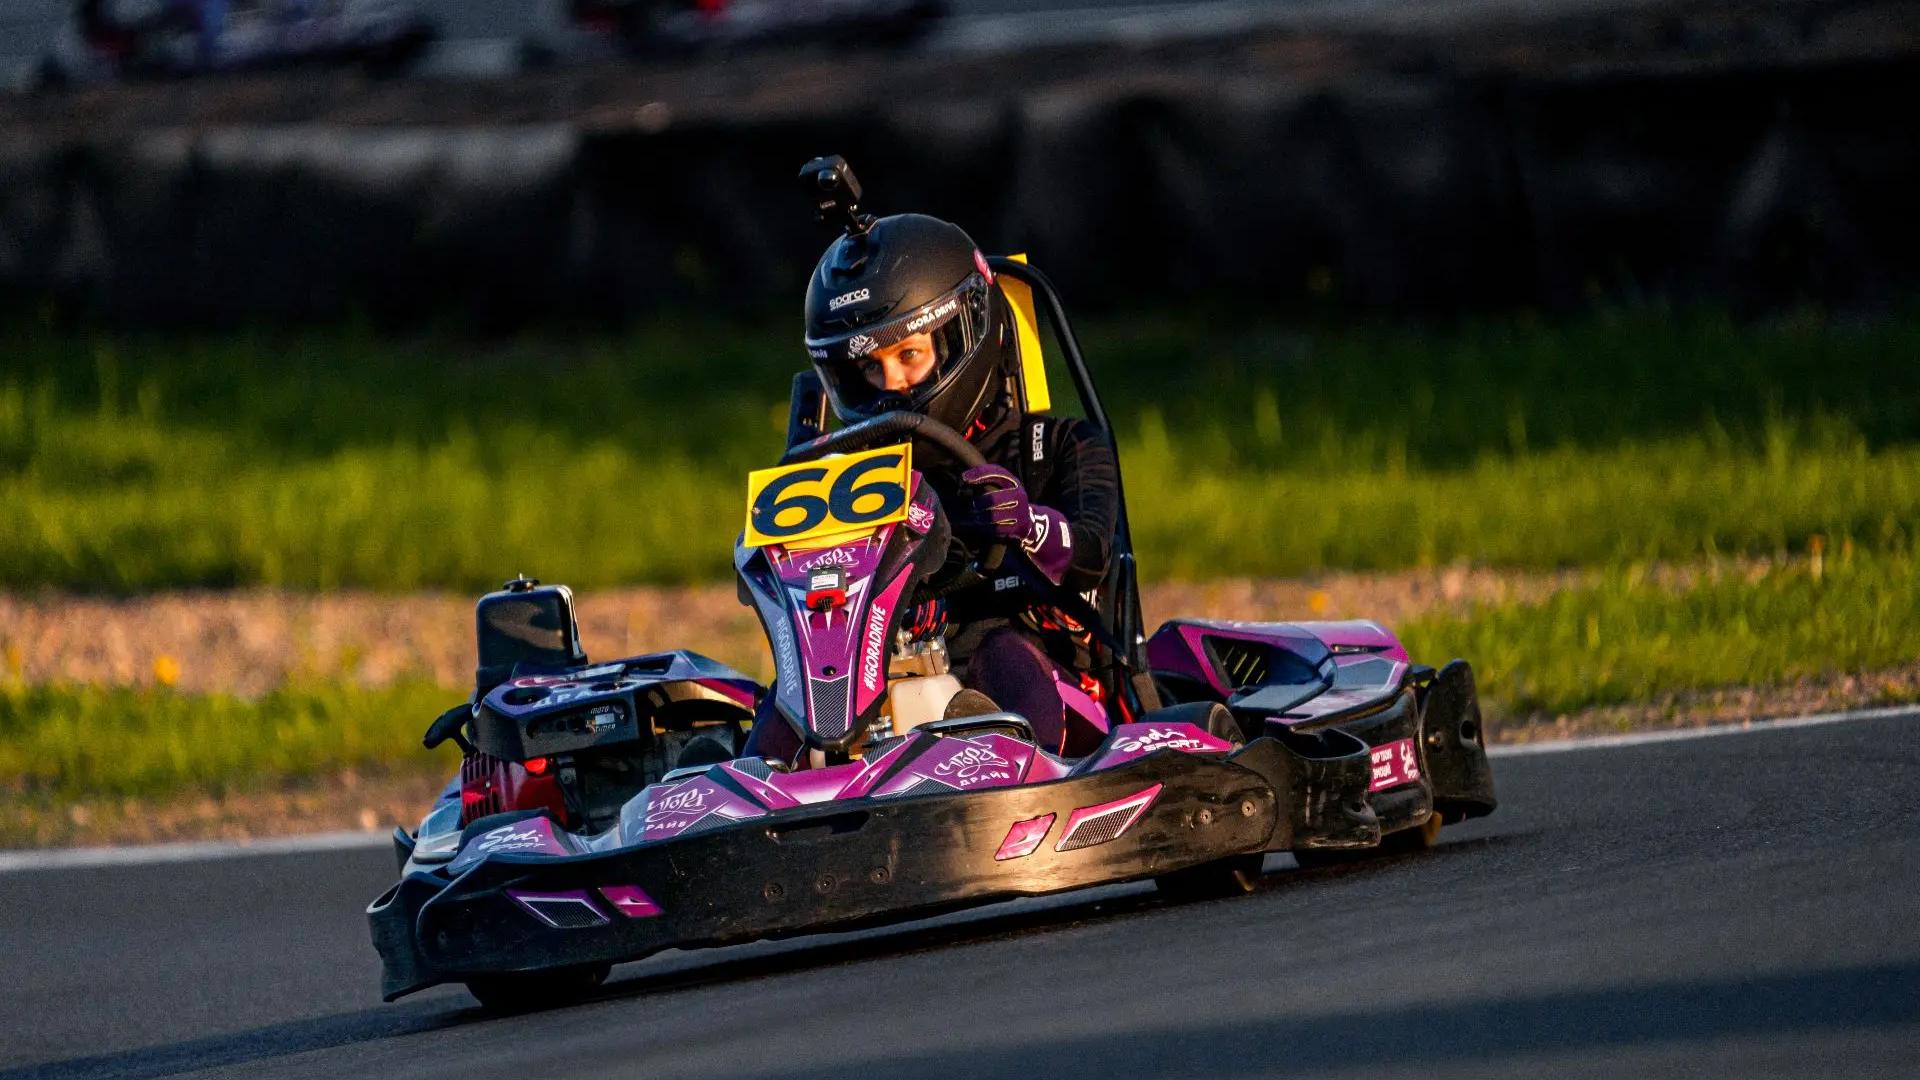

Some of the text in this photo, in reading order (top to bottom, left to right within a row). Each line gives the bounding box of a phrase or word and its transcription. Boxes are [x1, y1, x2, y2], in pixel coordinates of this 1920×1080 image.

[829, 288, 870, 311] sparco
[907, 299, 957, 332] IGORA DRIVE
[751, 453, 906, 537] 66
[776, 616, 798, 695] #IGORADRIVE
[864, 604, 886, 692] #IGORADRIVE
[1143, 740, 1202, 752] SPORT
[960, 771, 1010, 787] ДРАЙВ
